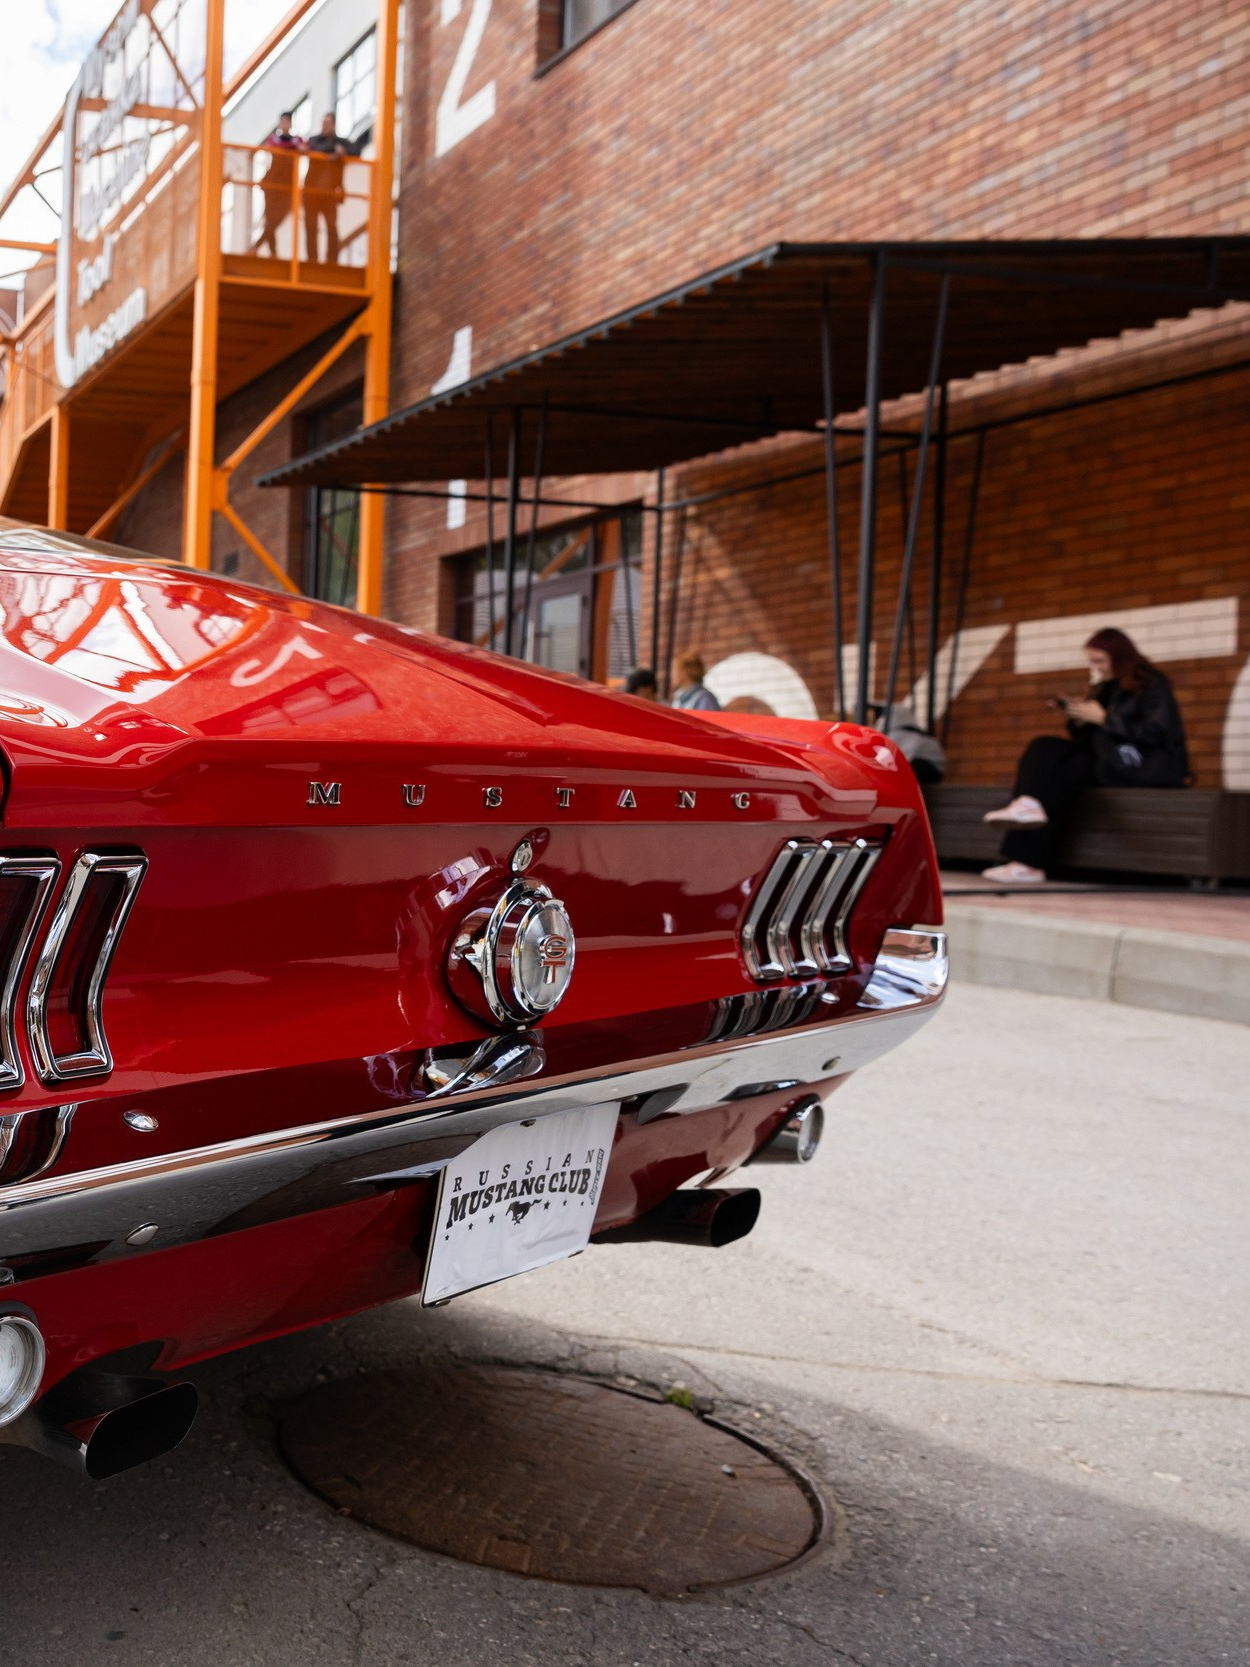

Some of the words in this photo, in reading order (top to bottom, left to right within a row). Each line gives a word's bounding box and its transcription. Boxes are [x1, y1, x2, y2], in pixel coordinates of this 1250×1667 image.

[307, 781, 750, 809] MUSTANG
[452, 1149, 595, 1193] RUSSIAN
[445, 1174, 546, 1230] MUSTANG
[547, 1168, 591, 1195] CLUB
